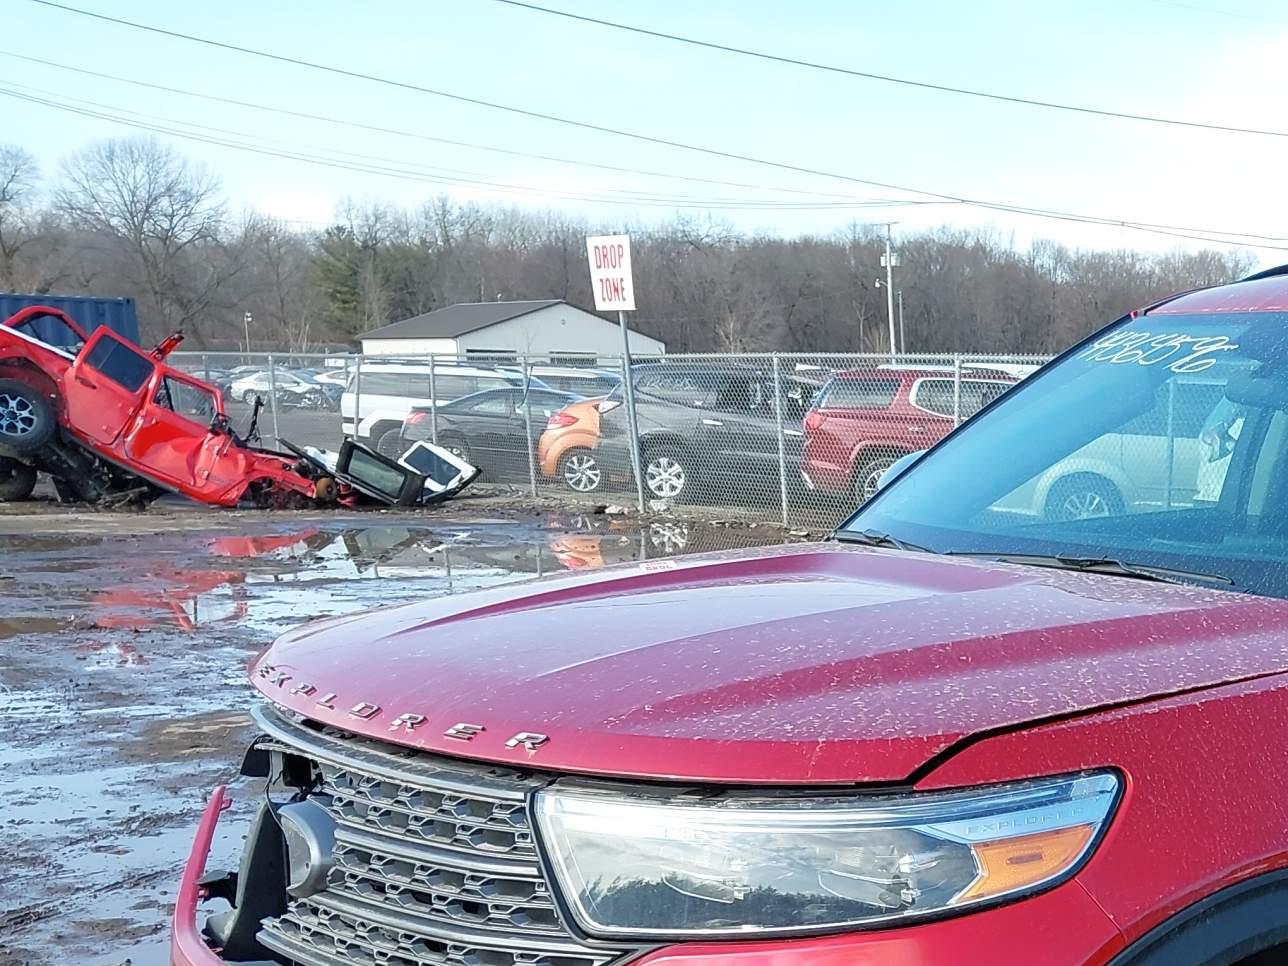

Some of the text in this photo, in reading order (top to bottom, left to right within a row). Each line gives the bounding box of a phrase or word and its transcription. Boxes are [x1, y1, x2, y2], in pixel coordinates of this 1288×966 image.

[594, 244, 624, 269] DROP
[600, 278, 626, 302] ZONE
[259, 663, 551, 752] EXPLORER
[965, 806, 1085, 836] EXPLOR
